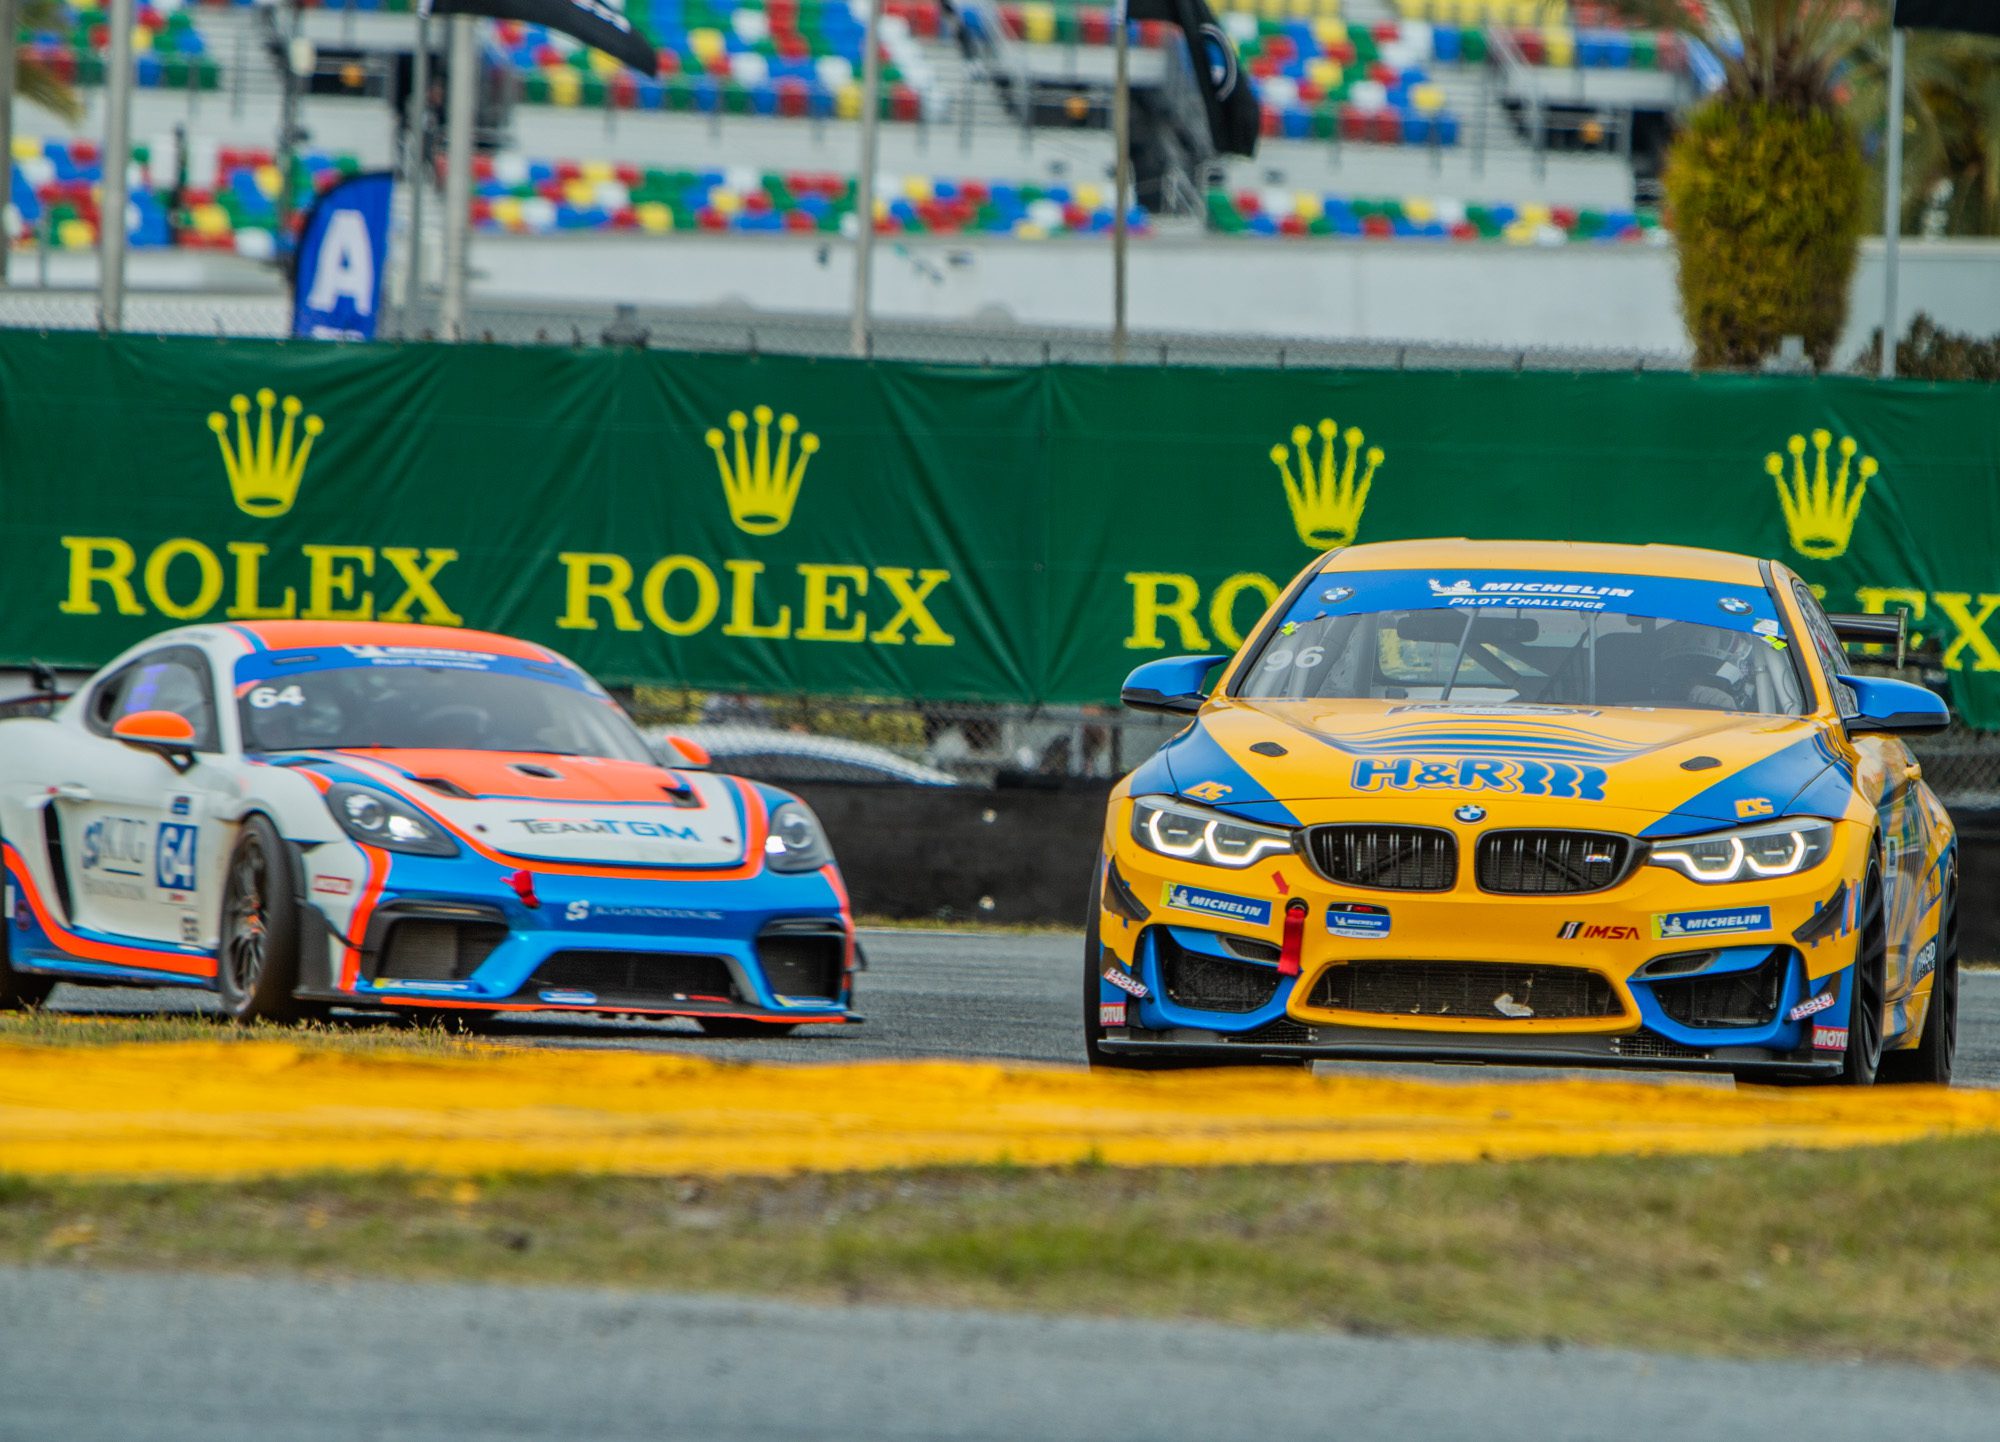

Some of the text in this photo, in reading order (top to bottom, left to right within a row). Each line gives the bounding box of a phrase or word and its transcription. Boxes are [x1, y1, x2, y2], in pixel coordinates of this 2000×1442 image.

[60, 535, 464, 627] ROLEX
[1481, 582, 1634, 598] MICHELIN
[556, 551, 955, 646] ROLEX
[1448, 596, 1607, 609] PILOT CHALLENGE
[1263, 645, 1325, 671] 96
[249, 685, 305, 708] 64
[159, 826, 196, 887] 64
[1190, 895, 1262, 917] MICHELIN
[1686, 914, 1762, 929] MICHELIN
[1583, 925, 1640, 940] IMSA
[1791, 993, 1833, 1013] LIQUI
[1814, 1029, 1848, 1047] MOTU
